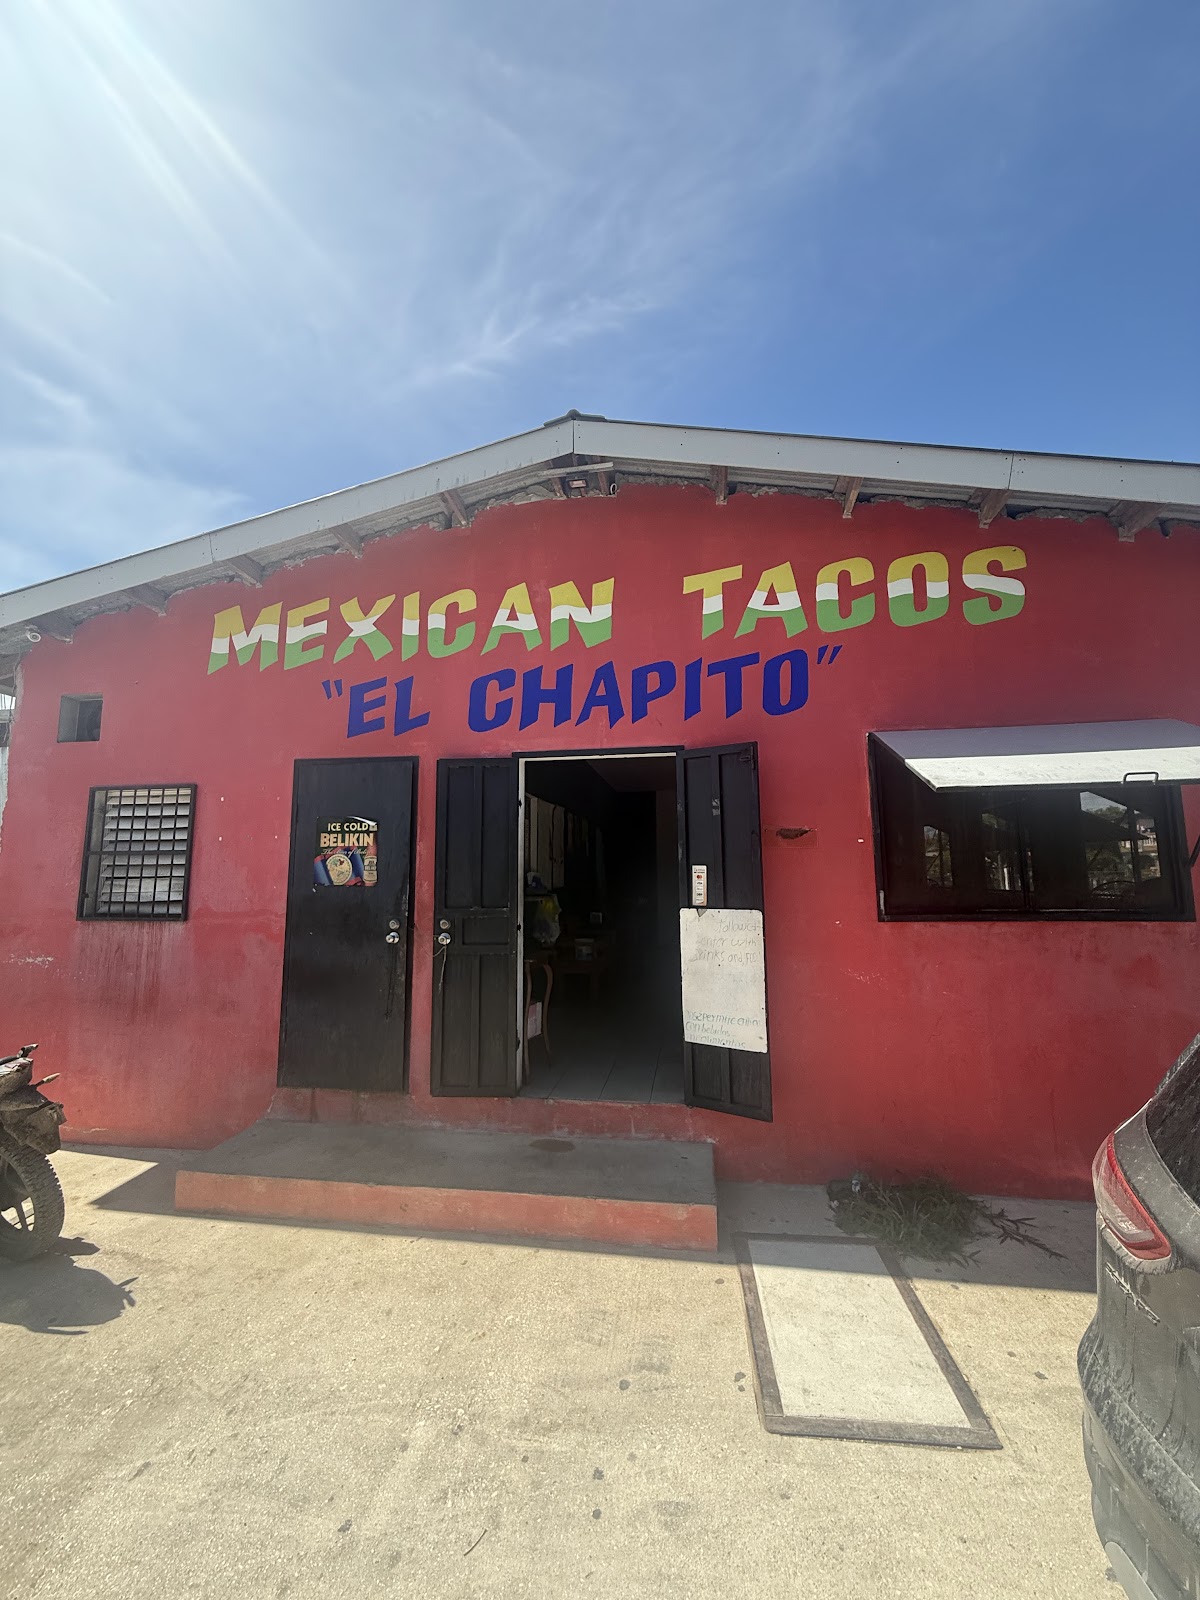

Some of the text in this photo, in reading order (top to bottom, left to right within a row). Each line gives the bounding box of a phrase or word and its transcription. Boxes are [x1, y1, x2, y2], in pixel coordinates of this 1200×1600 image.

[207, 545, 1027, 675] MEXICAN TACOS
[328, 823, 368, 831] ICE COLD
[320, 833, 374, 847] BELIKIN
